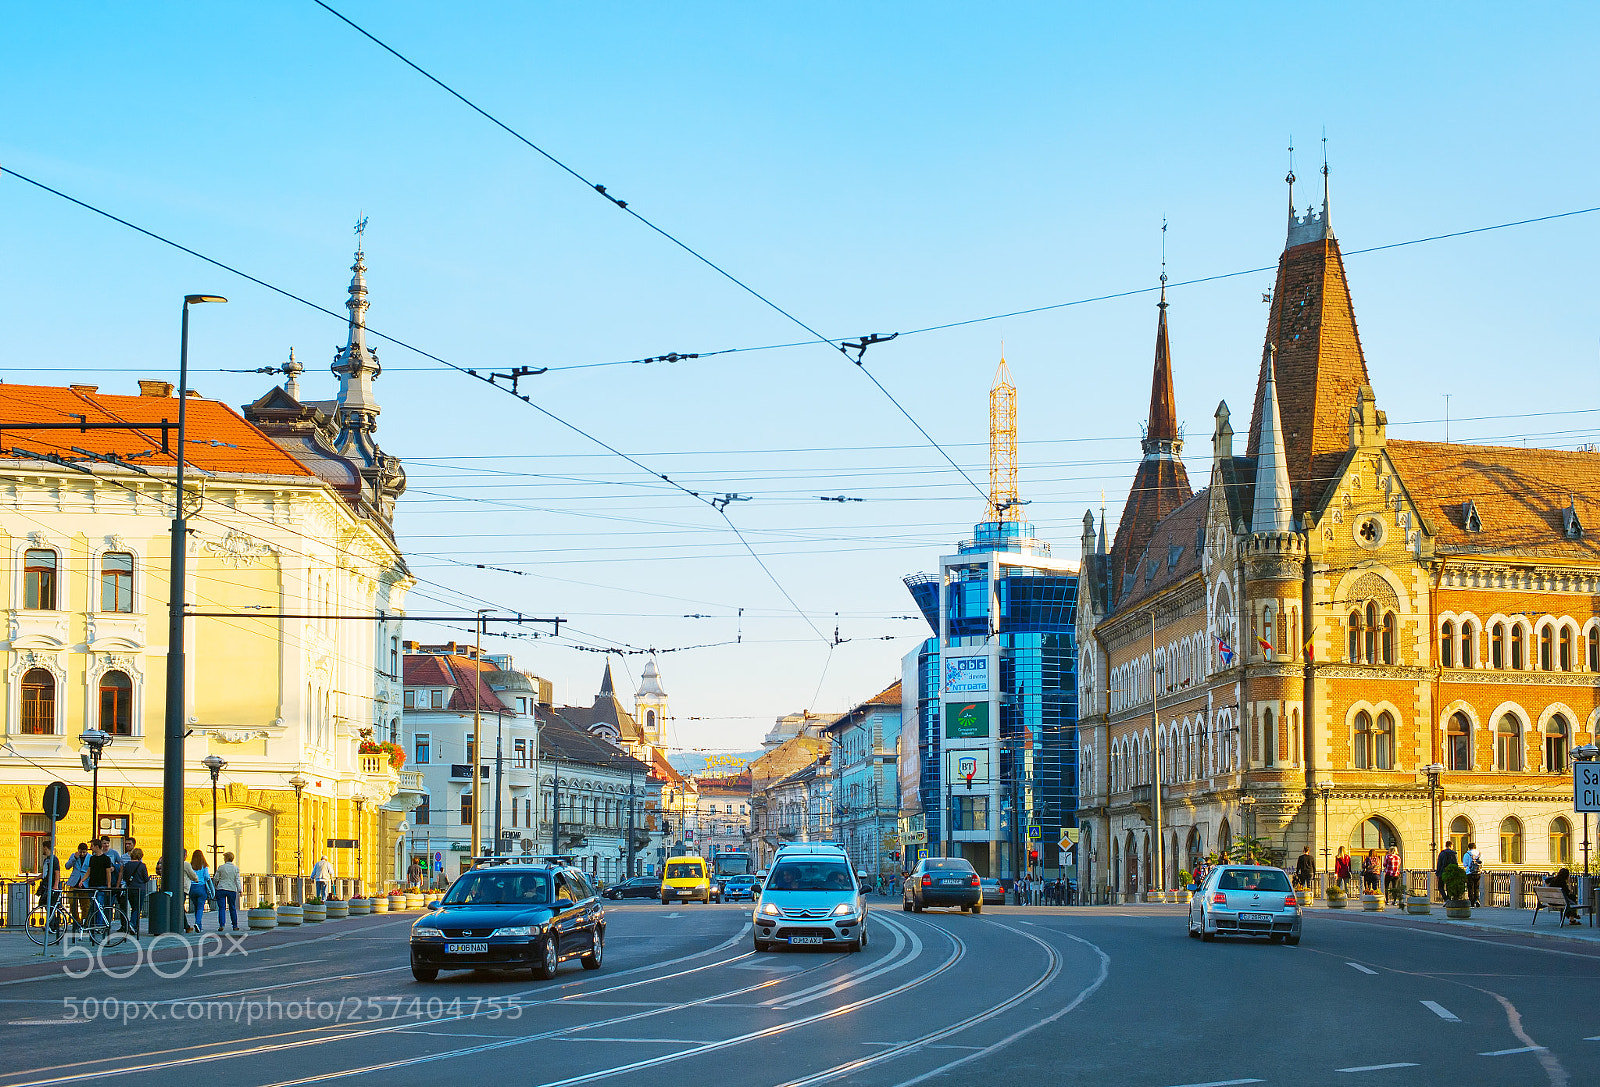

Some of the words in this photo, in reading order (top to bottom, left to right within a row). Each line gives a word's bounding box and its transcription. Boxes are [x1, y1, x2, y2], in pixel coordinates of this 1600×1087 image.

[961, 762, 973, 771] BT
[449, 944, 459, 952] CJ
[461, 944, 471, 952] 06
[471, 944, 487, 952] NAN
